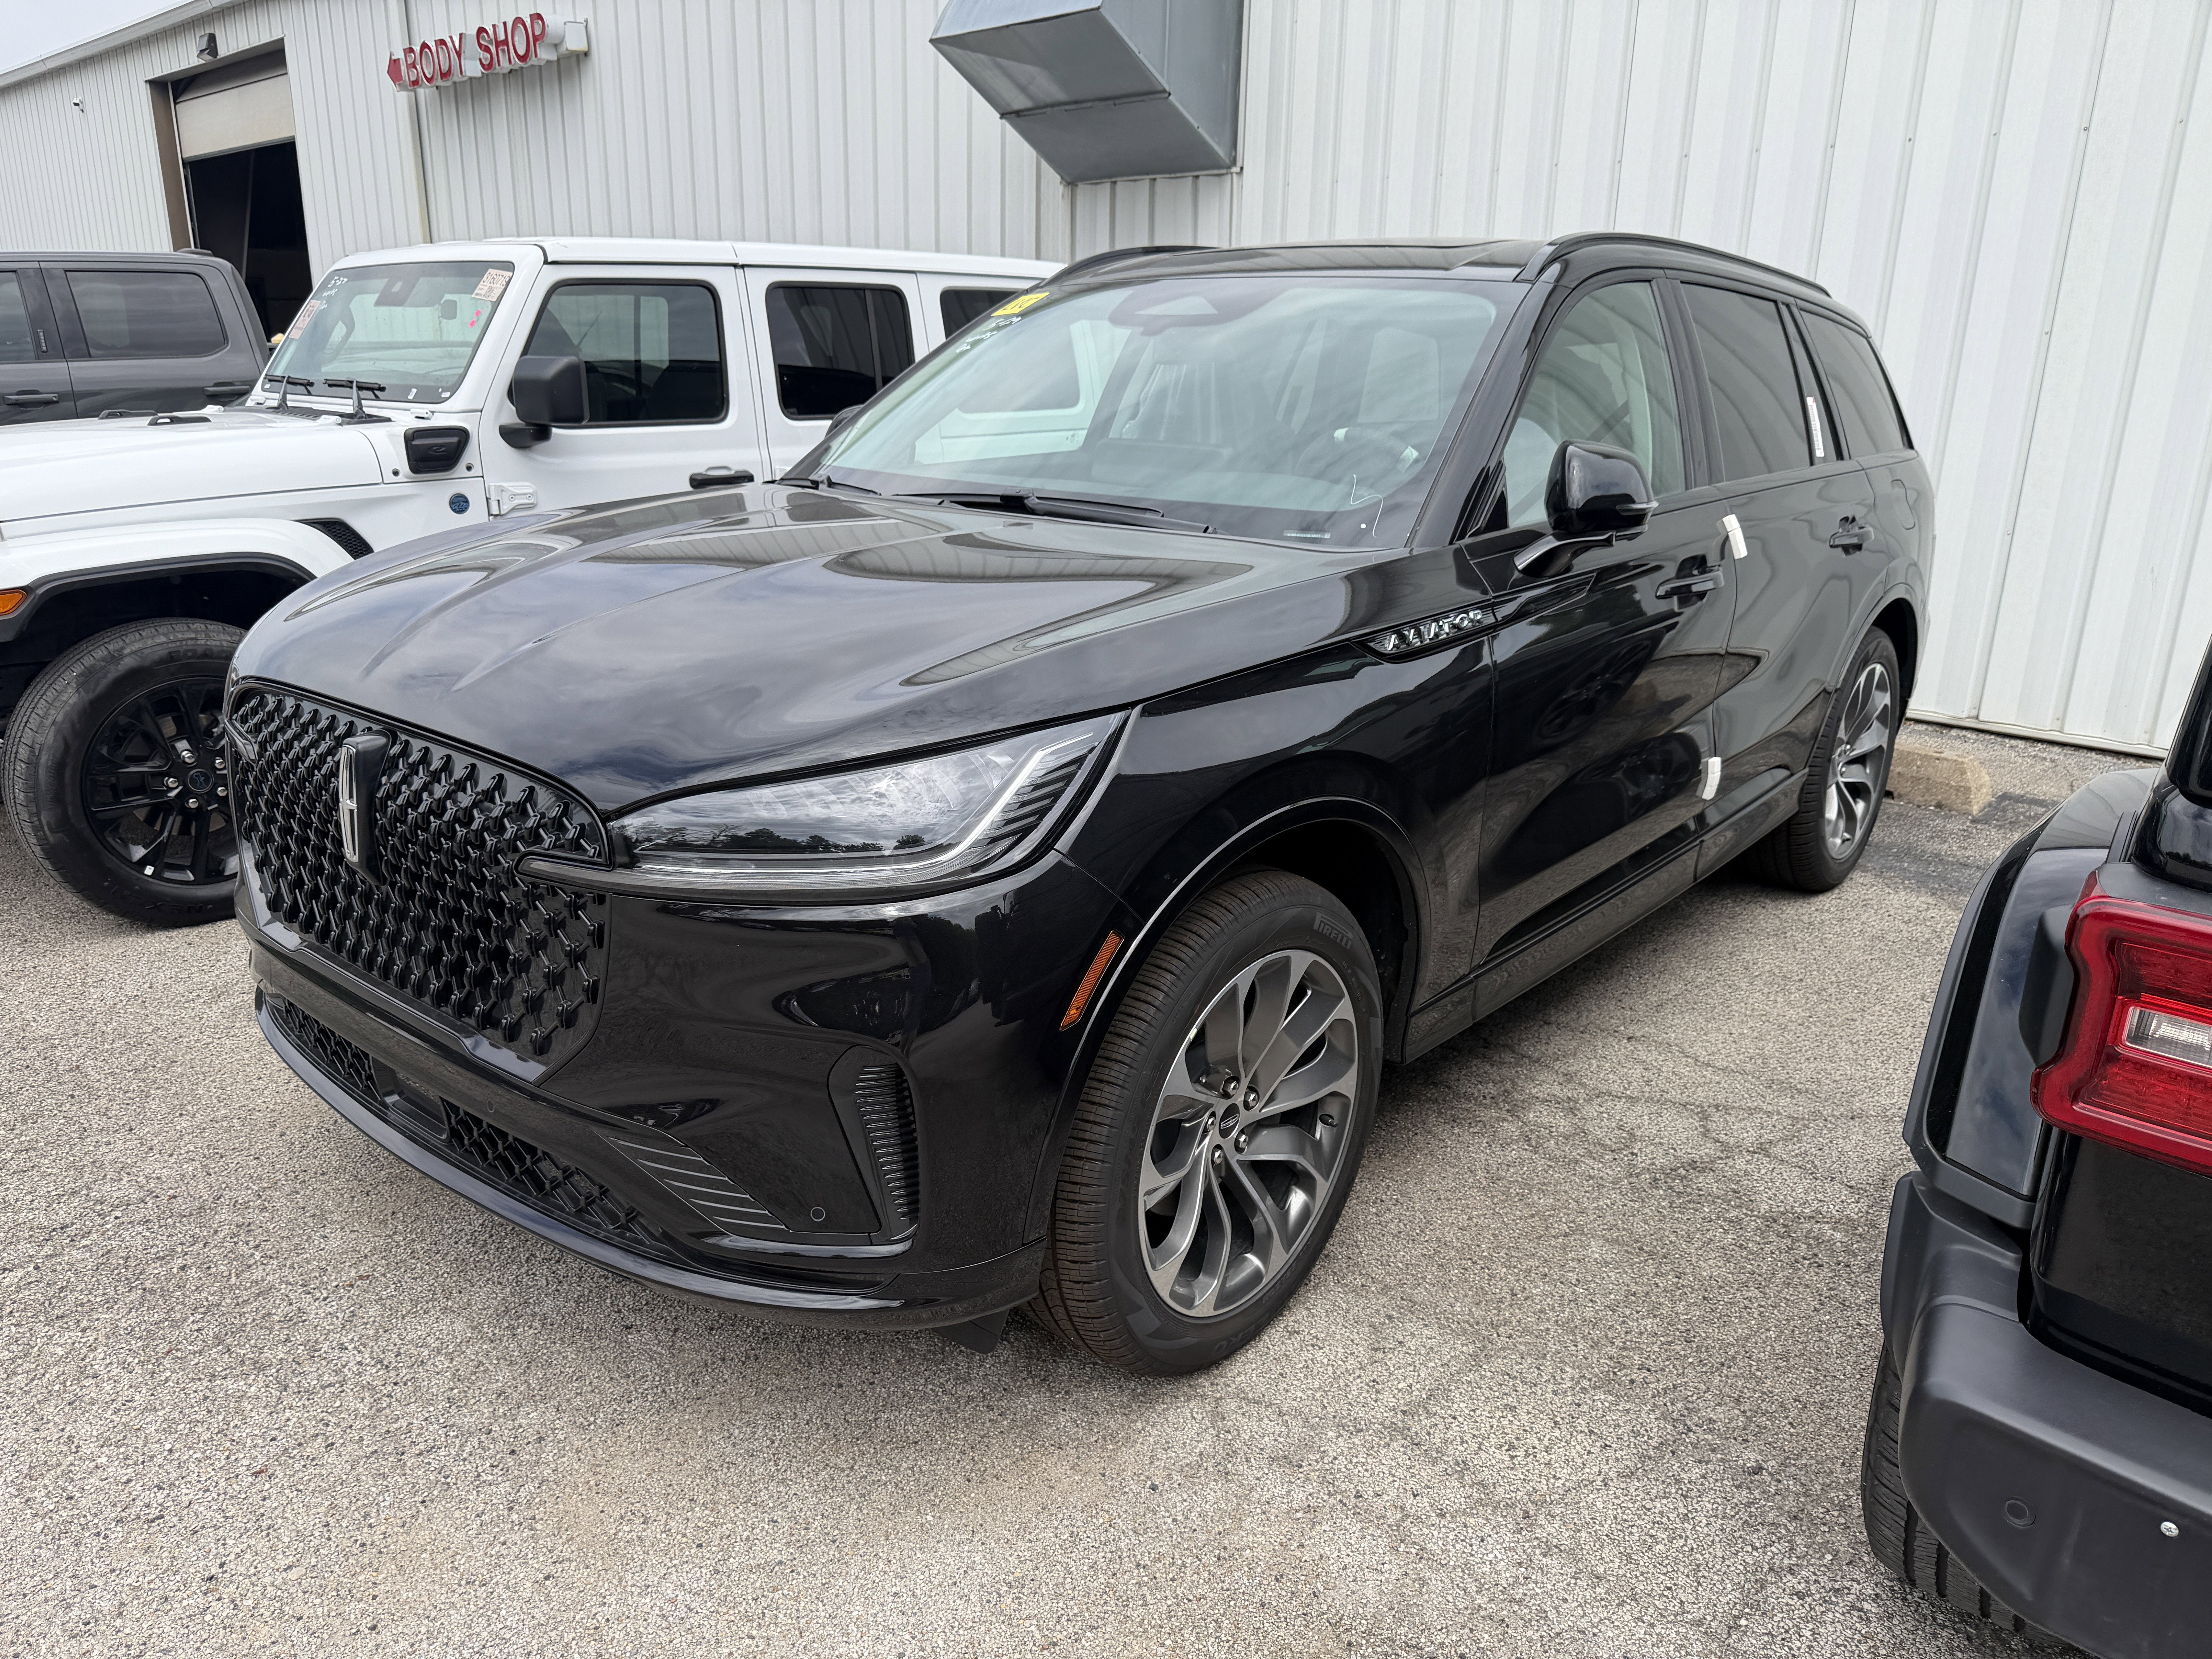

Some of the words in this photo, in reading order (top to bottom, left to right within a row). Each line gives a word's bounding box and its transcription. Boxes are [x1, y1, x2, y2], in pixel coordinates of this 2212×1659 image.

[403, 33, 464, 88] BODY
[476, 12, 546, 72] SHOP
[1387, 609, 1484, 651] AVIATOR
[1313, 912, 1353, 950] PIRELLI
